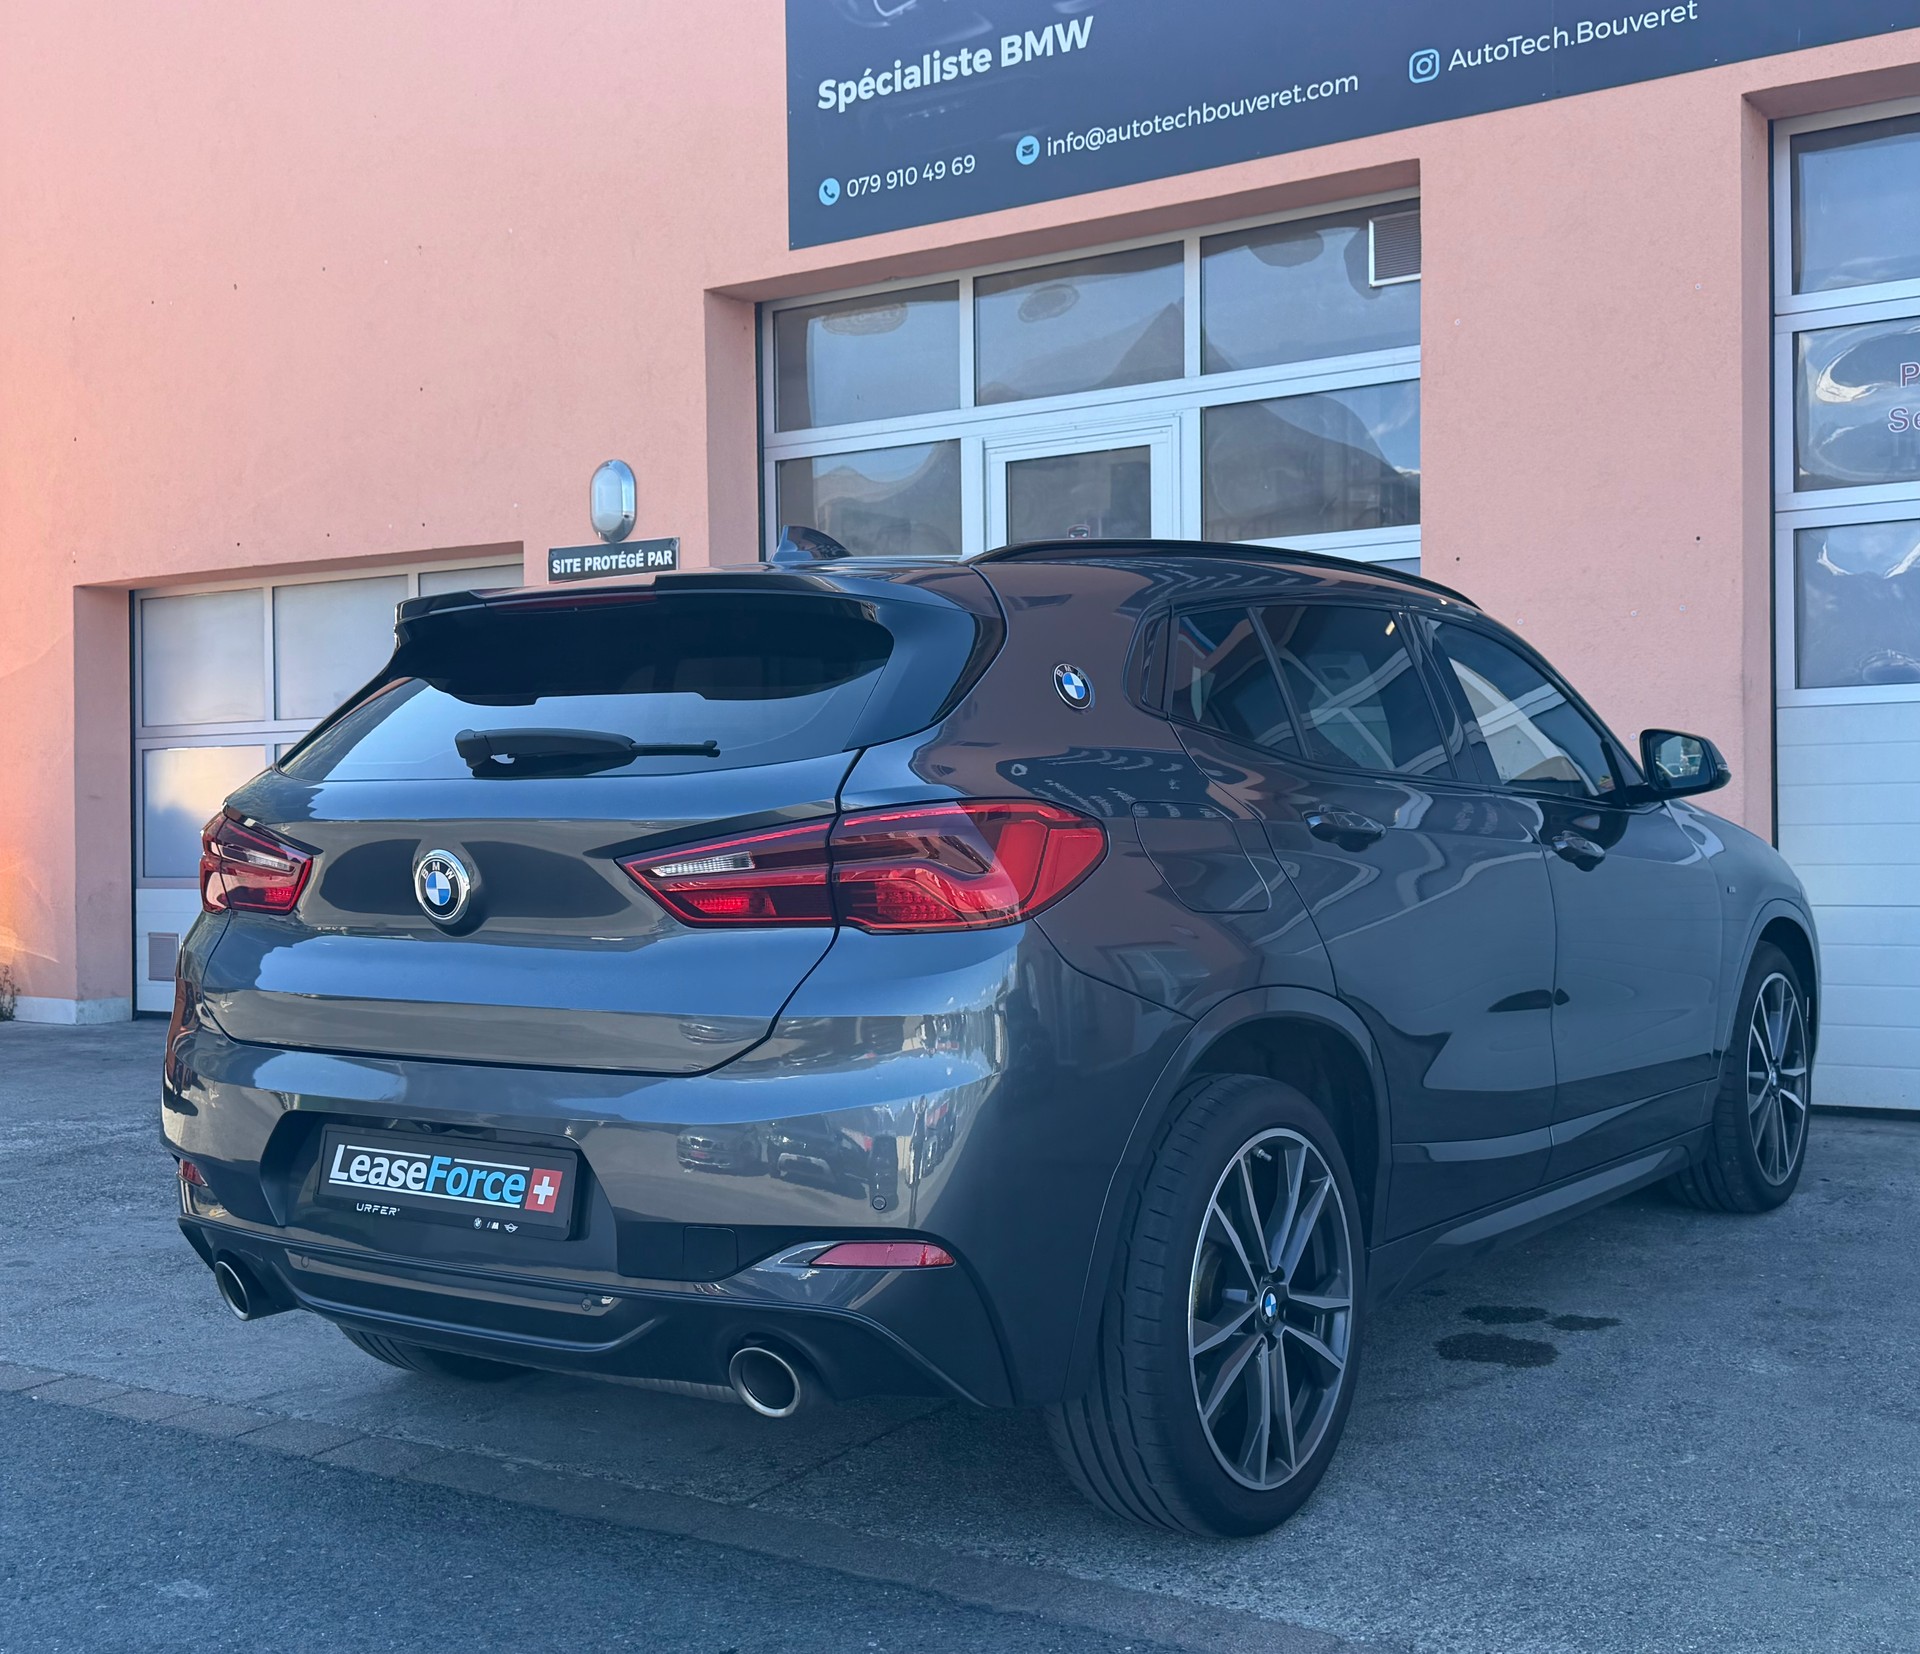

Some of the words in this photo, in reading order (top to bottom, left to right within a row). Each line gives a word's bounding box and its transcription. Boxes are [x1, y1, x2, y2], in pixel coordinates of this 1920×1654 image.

[817, 47, 993, 113] Spécialiste
[1000, 15, 1094, 68] BMW
[1448, 0, 1698, 71] AutoTech.Bouveret
[1047, 75, 1359, 157] info@autotechbouveret.com
[846, 174, 881, 197] 079
[886, 166, 918, 190] 910
[922, 160, 946, 182] 49
[951, 155, 976, 176] 69
[552, 558, 581, 574] SITE
[584, 549, 644, 572] PROTÉGÉ
[647, 550, 673, 566] PAR
[421, 861, 455, 880] BMW
[329, 1144, 526, 1204] LeaseForce
